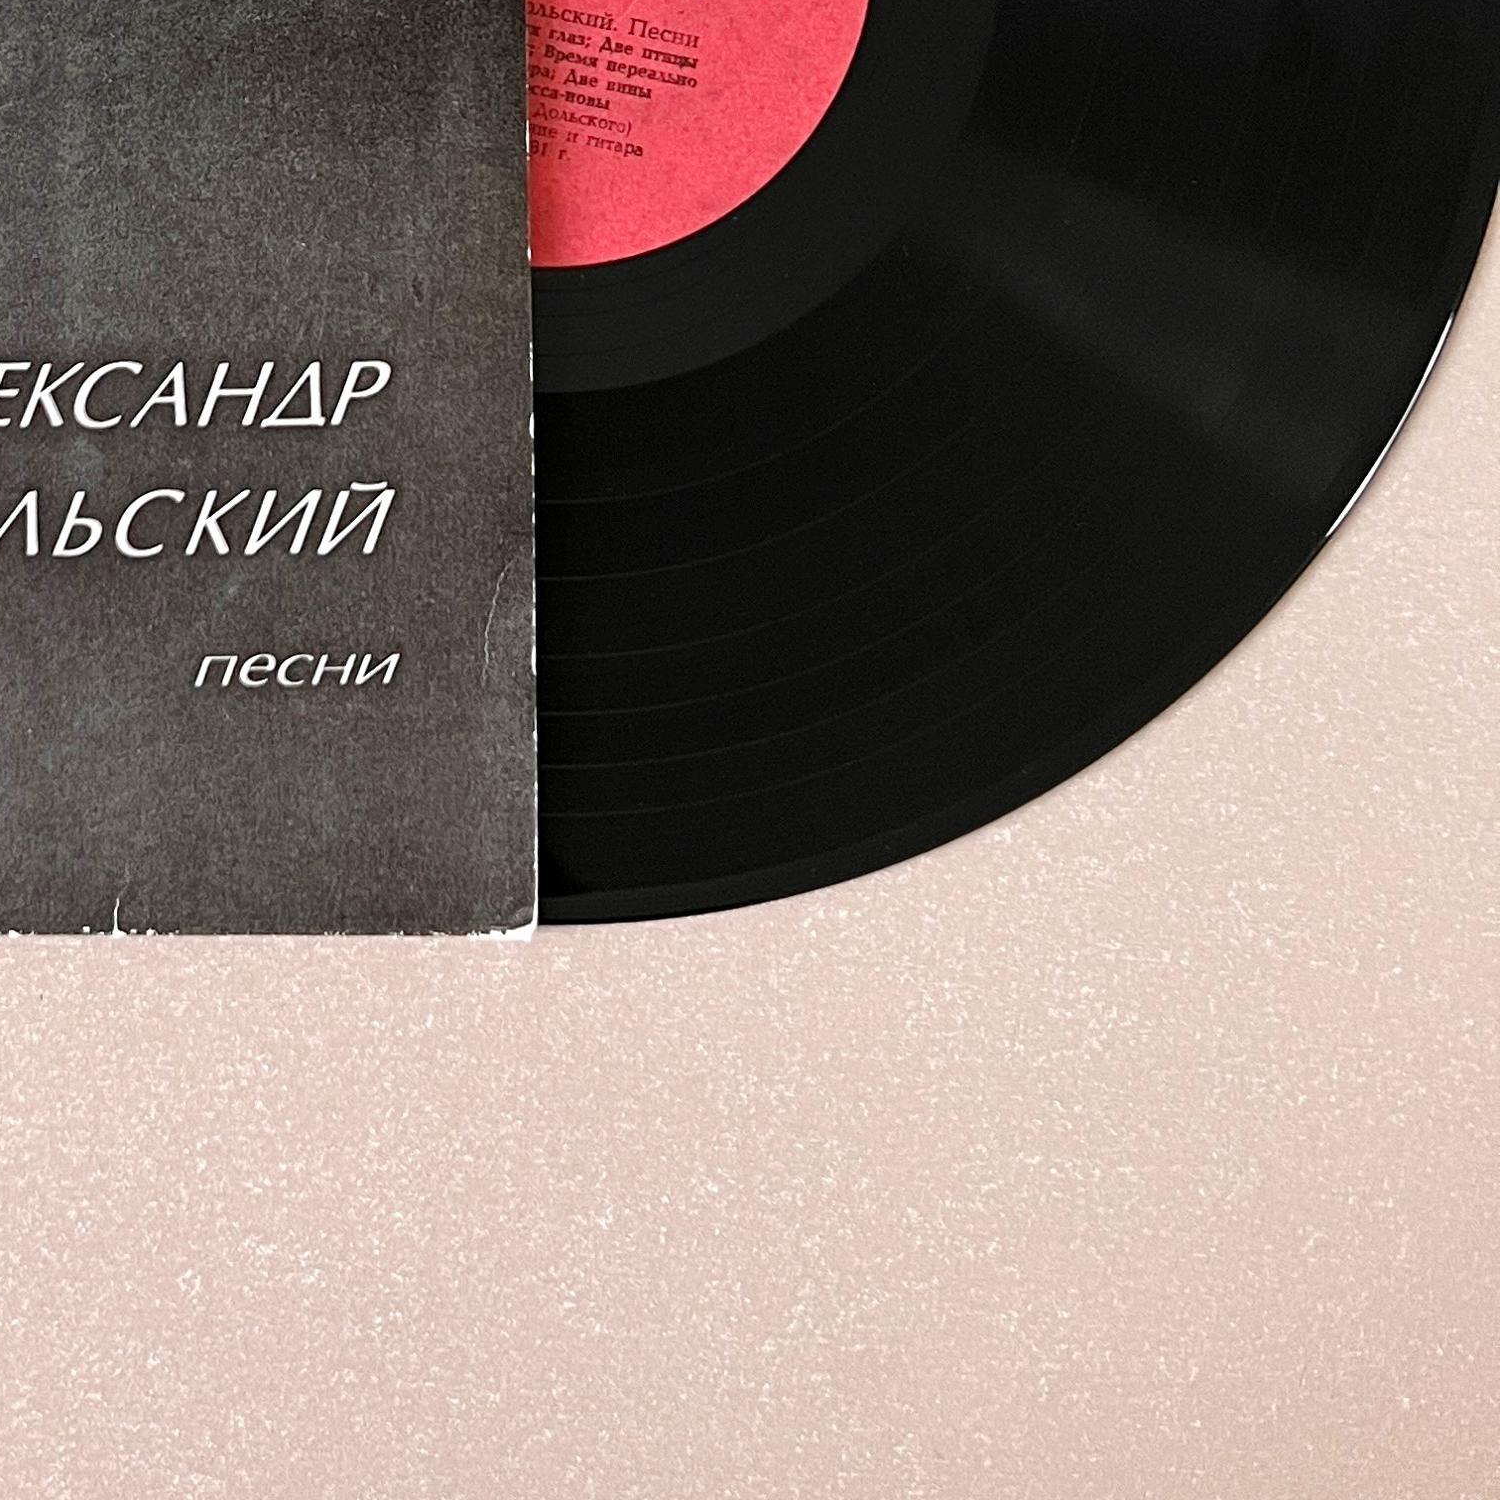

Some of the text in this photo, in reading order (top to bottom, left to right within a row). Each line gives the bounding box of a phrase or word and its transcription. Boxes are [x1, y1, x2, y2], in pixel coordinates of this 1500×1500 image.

[628, 17, 700, 48] Песни
[544, 44, 599, 68] Время
[548, 29, 593, 49] глаз;
[599, 36, 634, 56] Две
[641, 47, 699, 69] птицы
[564, 68, 599, 88] Две
[586, 135, 644, 158] гитара
[194, 651, 400, 688] песни
